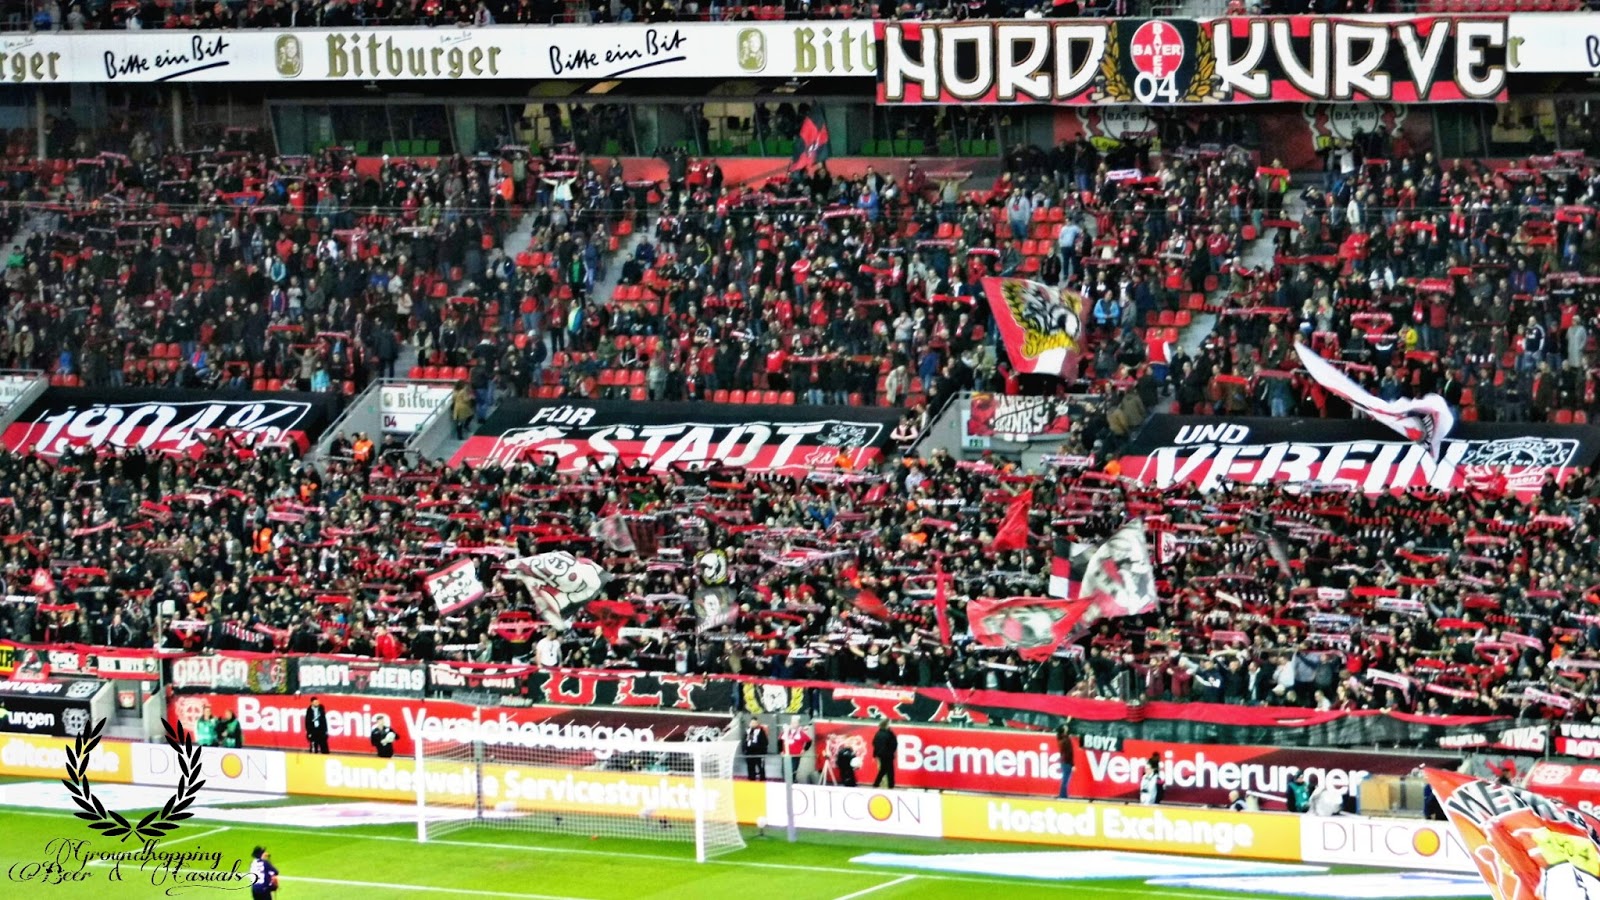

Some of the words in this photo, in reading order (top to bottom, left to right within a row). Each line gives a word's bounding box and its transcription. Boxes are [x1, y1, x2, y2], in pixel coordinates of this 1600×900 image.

[105, 51, 150, 79] Bitte
[155, 50, 188, 66] ein
[192, 35, 229, 61] Bit
[326, 33, 502, 79] Bitburger
[549, 45, 599, 75] Bitte
[605, 46, 643, 62] ein
[646, 29, 687, 54] Bit
[884, 21, 1109, 100] NORD
[1133, 44, 1181, 56] BAYER
[1212, 18, 1507, 99] KURVE
[1134, 71, 1179, 104] 04
[384, 416, 397, 428] D4
[528, 405, 597, 426] FÜR
[1173, 422, 1250, 444] UND
[573, 424, 825, 472] STADT
[1155, 441, 1467, 492] VEREIN
[896, 735, 1063, 781] Barmenia
[1084, 735, 1117, 752] BOYZ
[149, 748, 268, 782] DICON
[792, 788, 920, 823] DITCON
[988, 801, 1096, 837] Hosted
[1102, 807, 1254, 854] Exchange
[1322, 822, 1471, 858] DITCON
